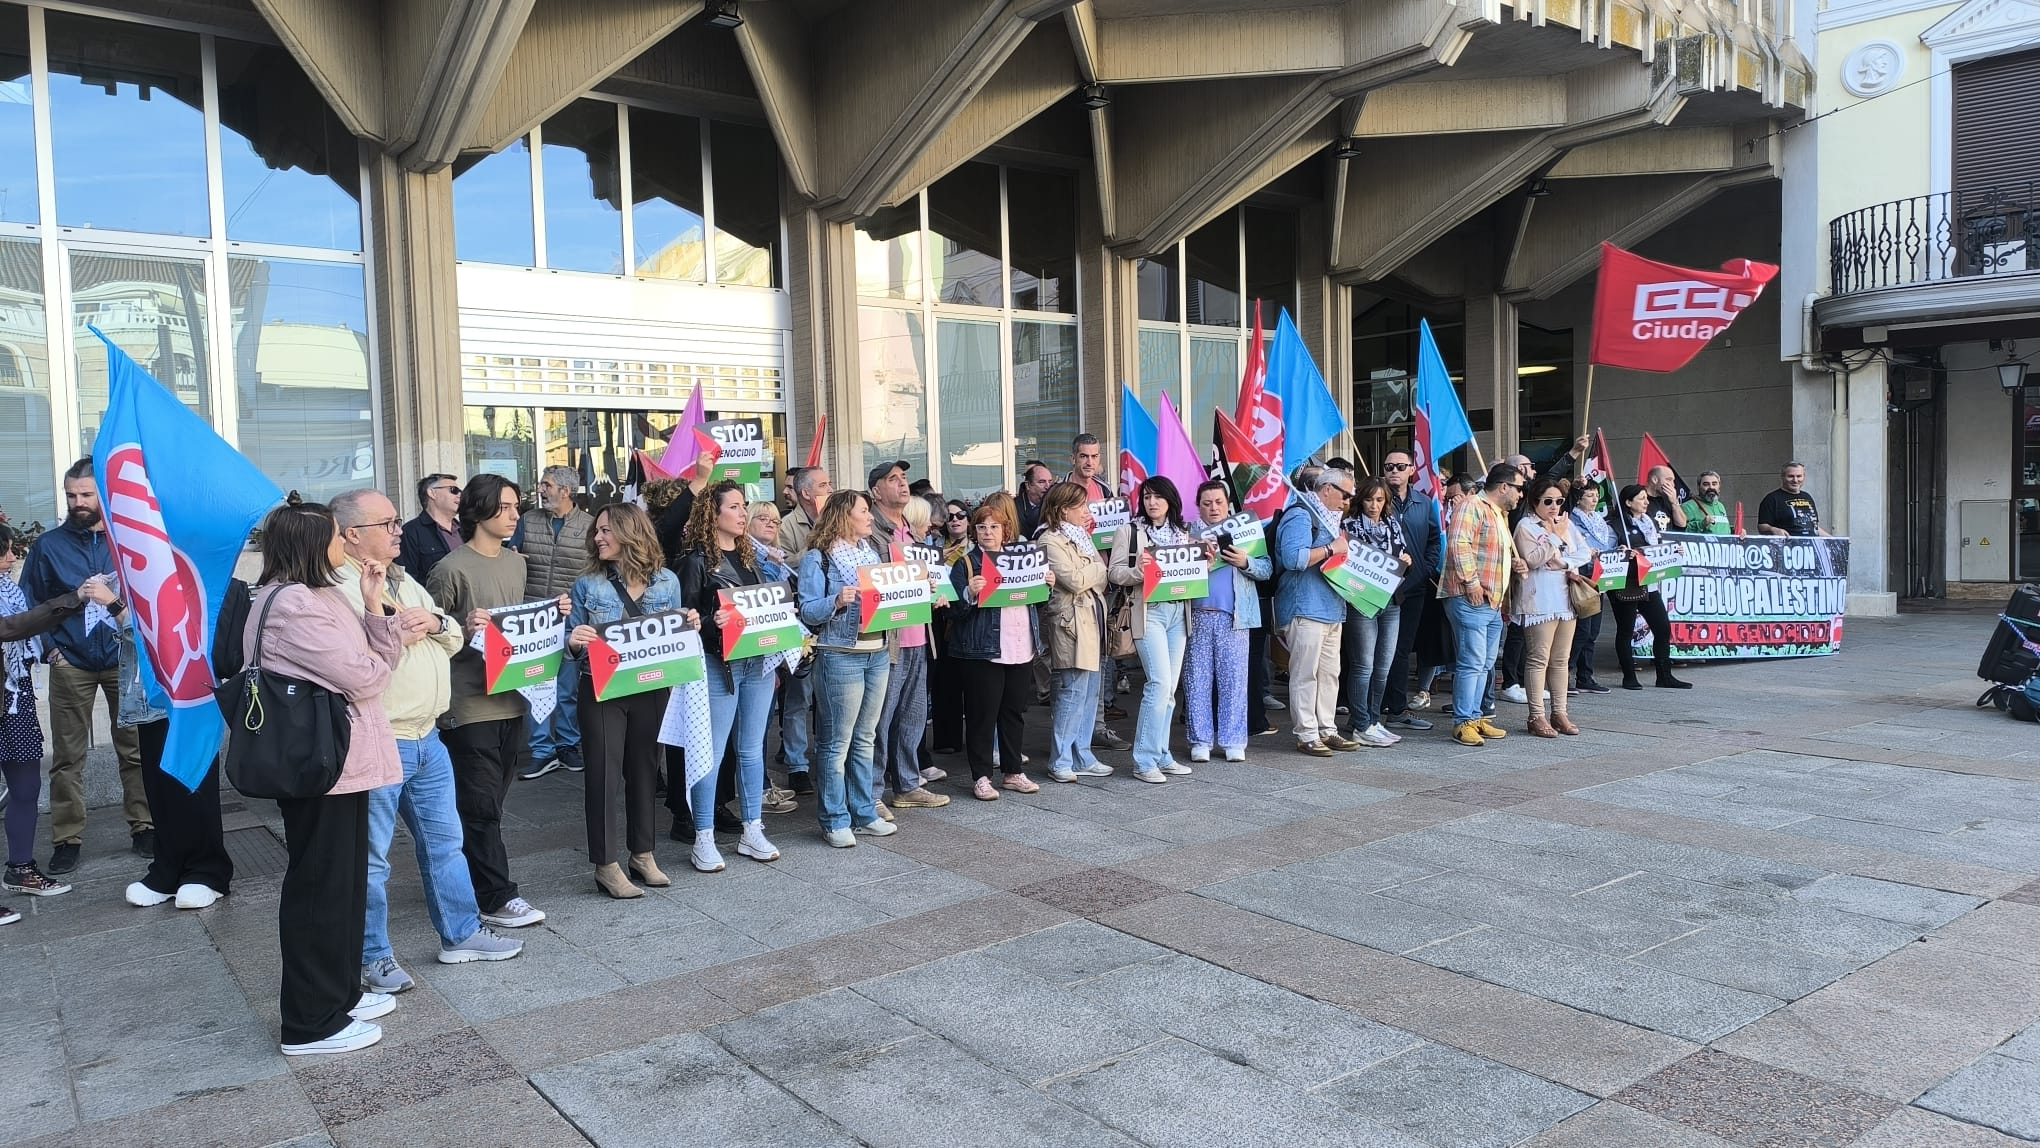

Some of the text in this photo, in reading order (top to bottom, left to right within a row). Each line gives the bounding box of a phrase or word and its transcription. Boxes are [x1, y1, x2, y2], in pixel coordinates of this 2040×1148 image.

[711, 424, 757, 442] STOP
[1088, 499, 1125, 516] STOP
[1201, 513, 1250, 540] STOP
[1232, 528, 1257, 540] CIDIO
[904, 545, 940, 565] STOP
[996, 550, 1044, 570] STOP
[1155, 547, 1201, 564] STOP
[1348, 540, 1399, 573] STOP
[1600, 552, 1626, 564] STOP
[1646, 544, 1680, 558] STOP
[1682, 540, 1816, 570] ABAJADOR@S CON
[870, 565, 921, 585] STOP
[994, 572, 1044, 584] GENOCIDIO
[1155, 567, 1200, 578] GENOCIDIO
[732, 586, 785, 609] STOP
[872, 588, 923, 603] GENOCIDIO
[1660, 576, 1847, 615] PUEBLO PALESTINO
[502, 607, 558, 636] STOP
[736, 611, 788, 628] GENOCIDIO
[605, 615, 683, 645] STOP
[1670, 624, 1710, 643] LTO
[1715, 624, 1733, 642] AL
[501, 635, 558, 657] GENOCIDIO
[608, 641, 686, 665] GENOCIDIO
[640, 671, 663, 681] CCOO
[287, 685, 296, 695] E
